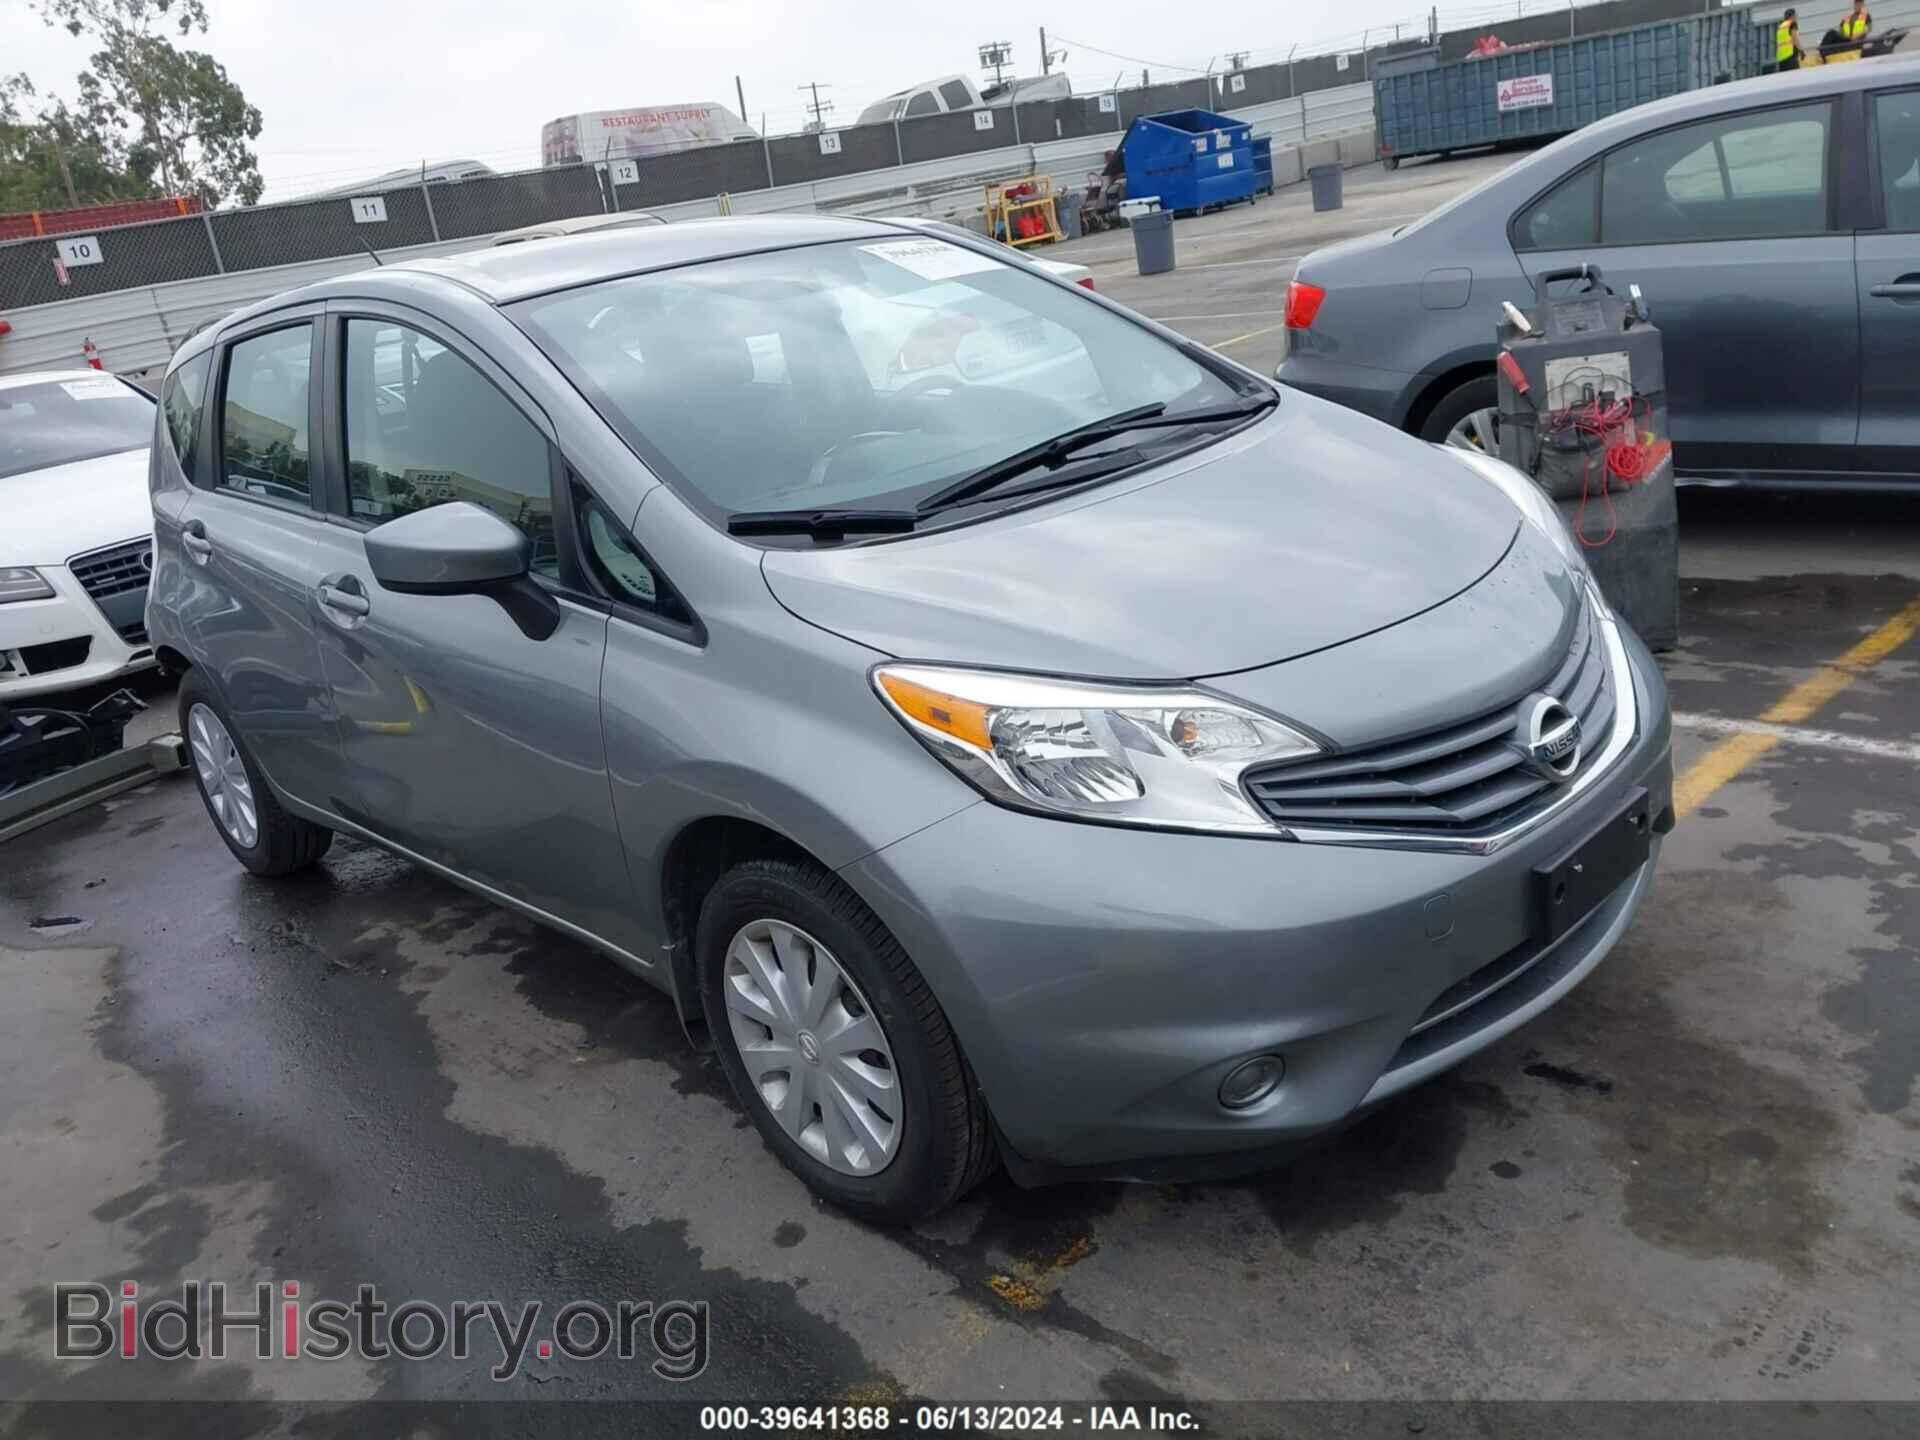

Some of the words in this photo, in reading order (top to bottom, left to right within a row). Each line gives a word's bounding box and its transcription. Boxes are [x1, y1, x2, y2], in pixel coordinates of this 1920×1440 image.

[601, 109, 669, 128] RESTAURANT
[674, 105, 711, 122] SUPPLY
[825, 137, 836, 149] 13
[619, 167, 632, 179] 12
[362, 203, 377, 217] 11
[69, 244, 90, 259] 10
